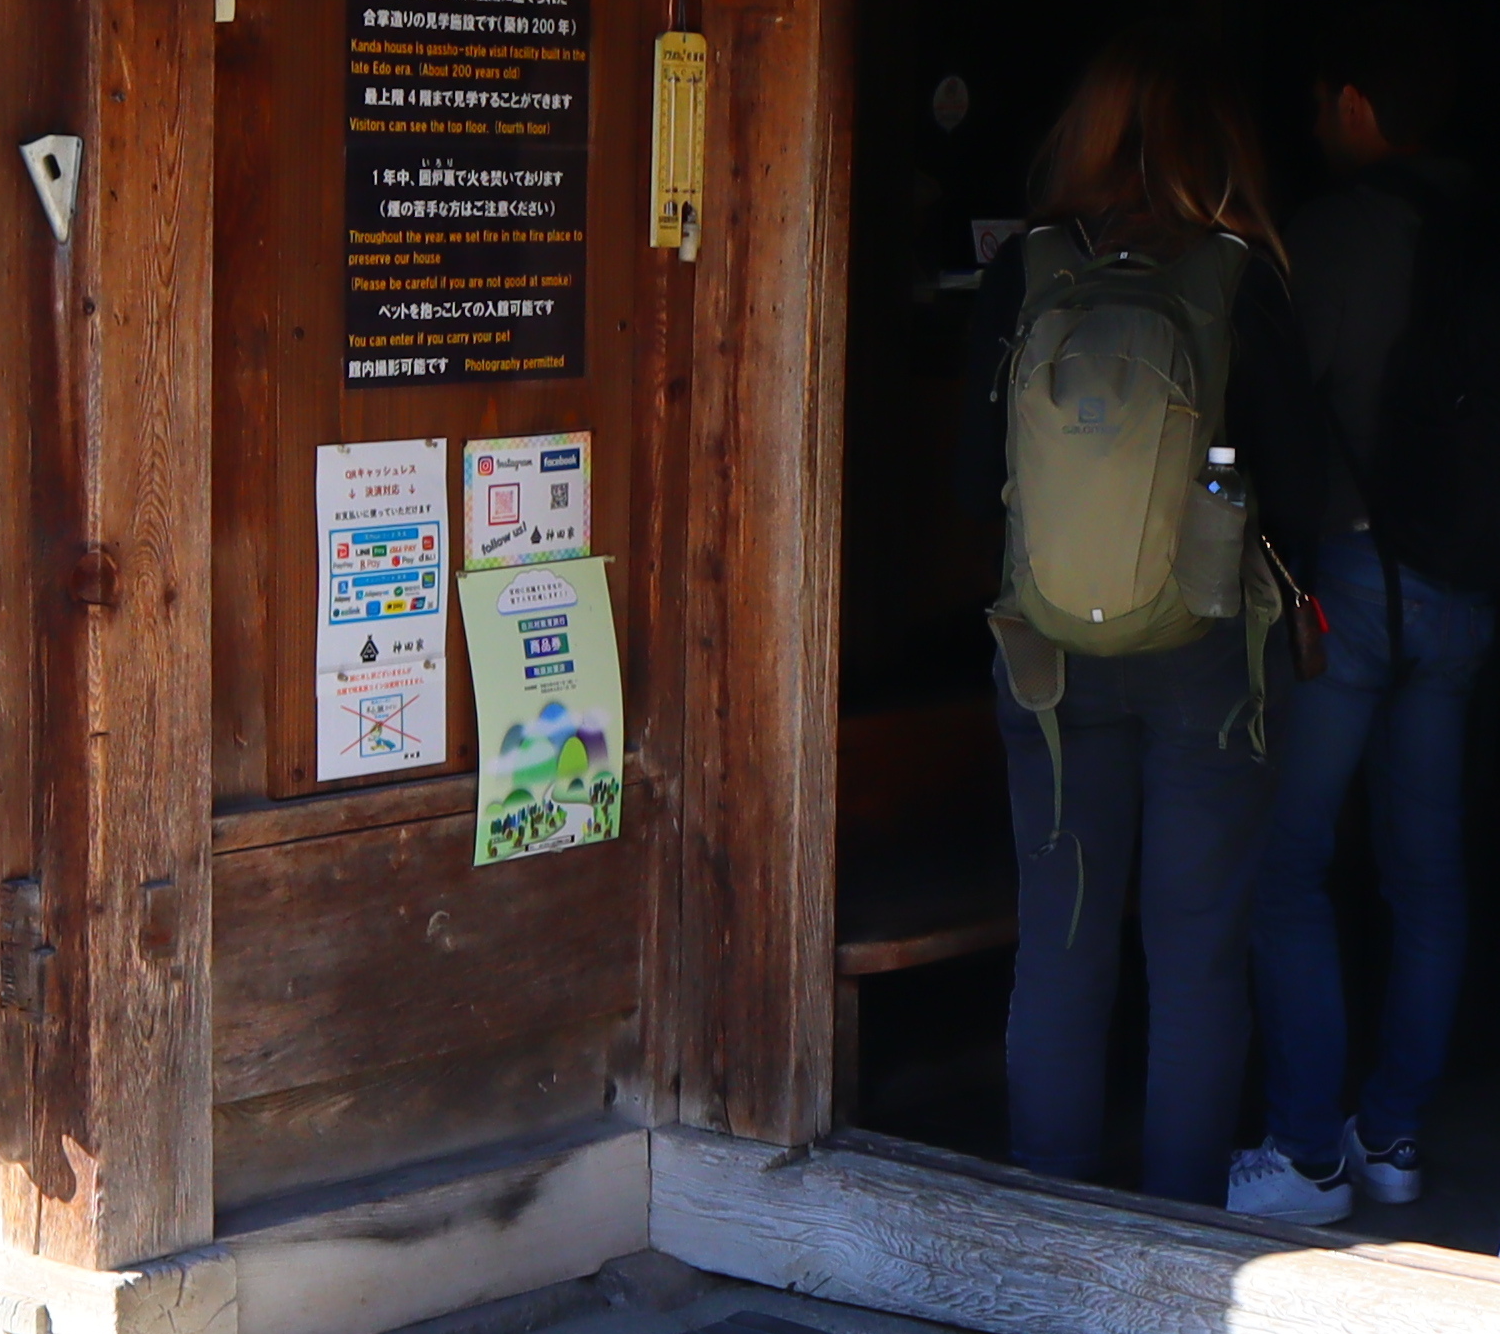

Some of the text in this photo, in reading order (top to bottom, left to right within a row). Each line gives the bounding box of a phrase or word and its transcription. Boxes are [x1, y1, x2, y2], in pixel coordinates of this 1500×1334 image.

[350, 38, 586, 61] Kanda house is gassho-style visit facility built in the
[350, 60, 520, 79] late Edo era. (About 200 years old)
[349, 117, 550, 134] Visitors can see the top floor. (fourth floor)
[348, 229, 403, 244] Throughout
[406, 230, 422, 243] the
[449, 232, 462, 242] we
[464, 230, 480, 242] set
[482, 229, 499, 242] fire
[501, 229, 510, 241] in
[512, 230, 527, 241] the
[528, 229, 544, 241] fire
[546, 230, 571, 242] place
[573, 230, 583, 241] to
[348, 251, 441, 265] preserve our house
[351, 274, 572, 291] (Please be careful if you are not good at smoke)
[348, 330, 510, 347] You can enter if you carry your pet
[464, 355, 565, 371] Photography permitted
[544, 454, 577, 466] facebook
[481, 520, 527, 555] follow us!
